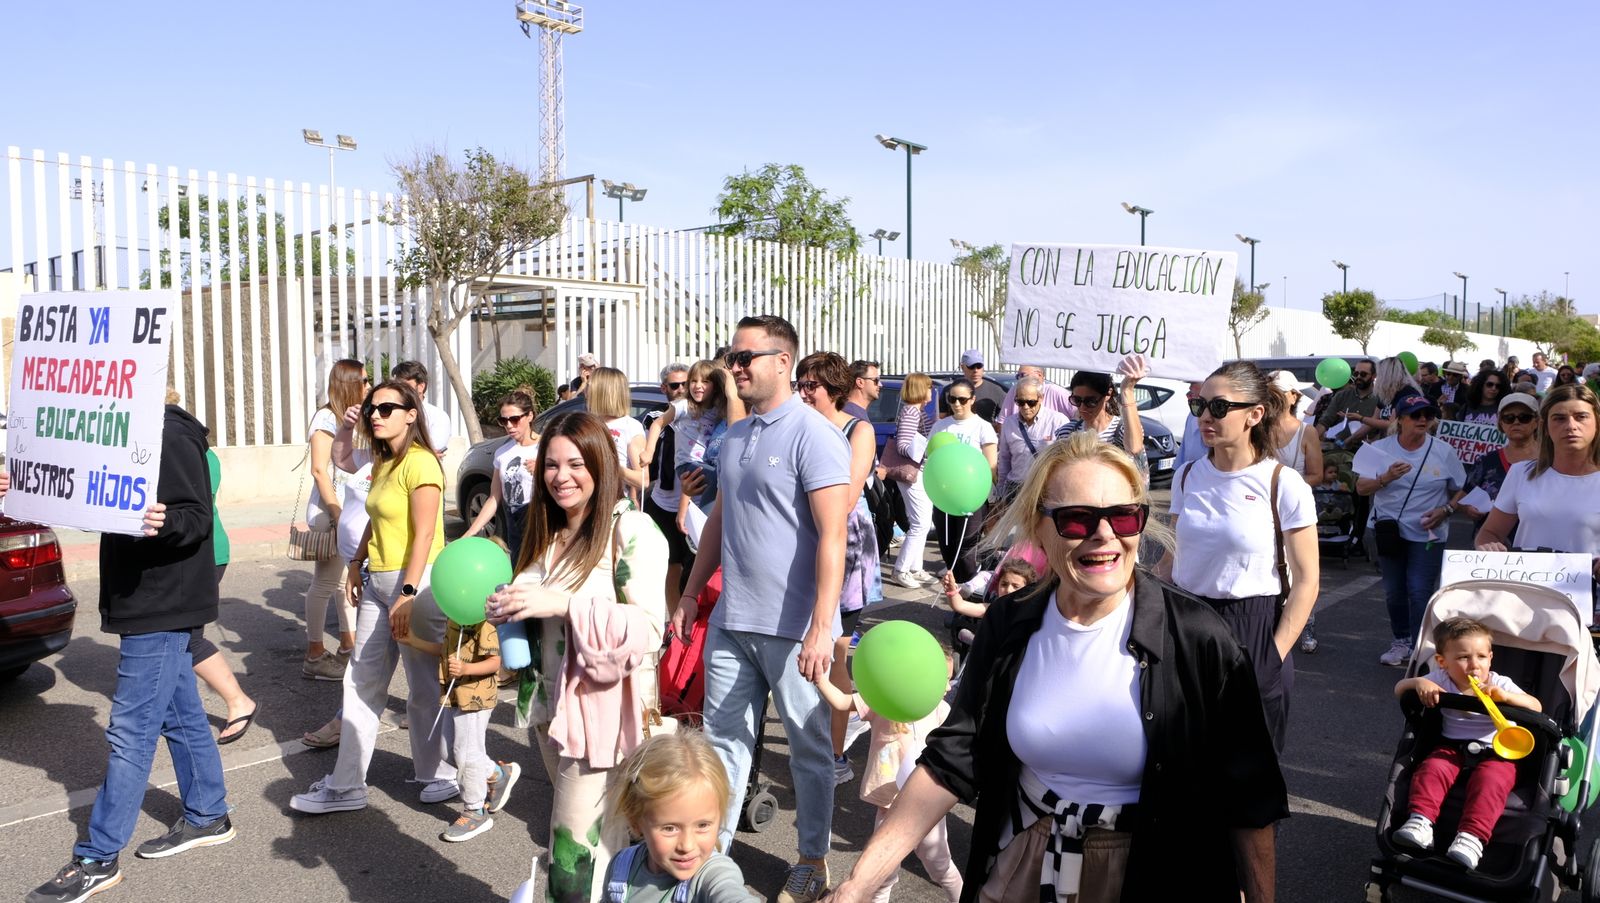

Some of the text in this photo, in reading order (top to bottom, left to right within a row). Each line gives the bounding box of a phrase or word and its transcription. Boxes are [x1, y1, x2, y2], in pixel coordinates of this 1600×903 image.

[1021, 247, 1223, 296] CON LA EDUCACIÓN
[20, 304, 167, 345] BASTA YA DE
[1013, 308, 1166, 359] NO SE JUEGA
[21, 356, 137, 400] MERCADEAR
[131, 441, 152, 465] de
[9, 457, 75, 500] NUESTROS
[1447, 554, 1524, 565] CON LA
[1470, 567, 1580, 583] EDUCACIÓN
